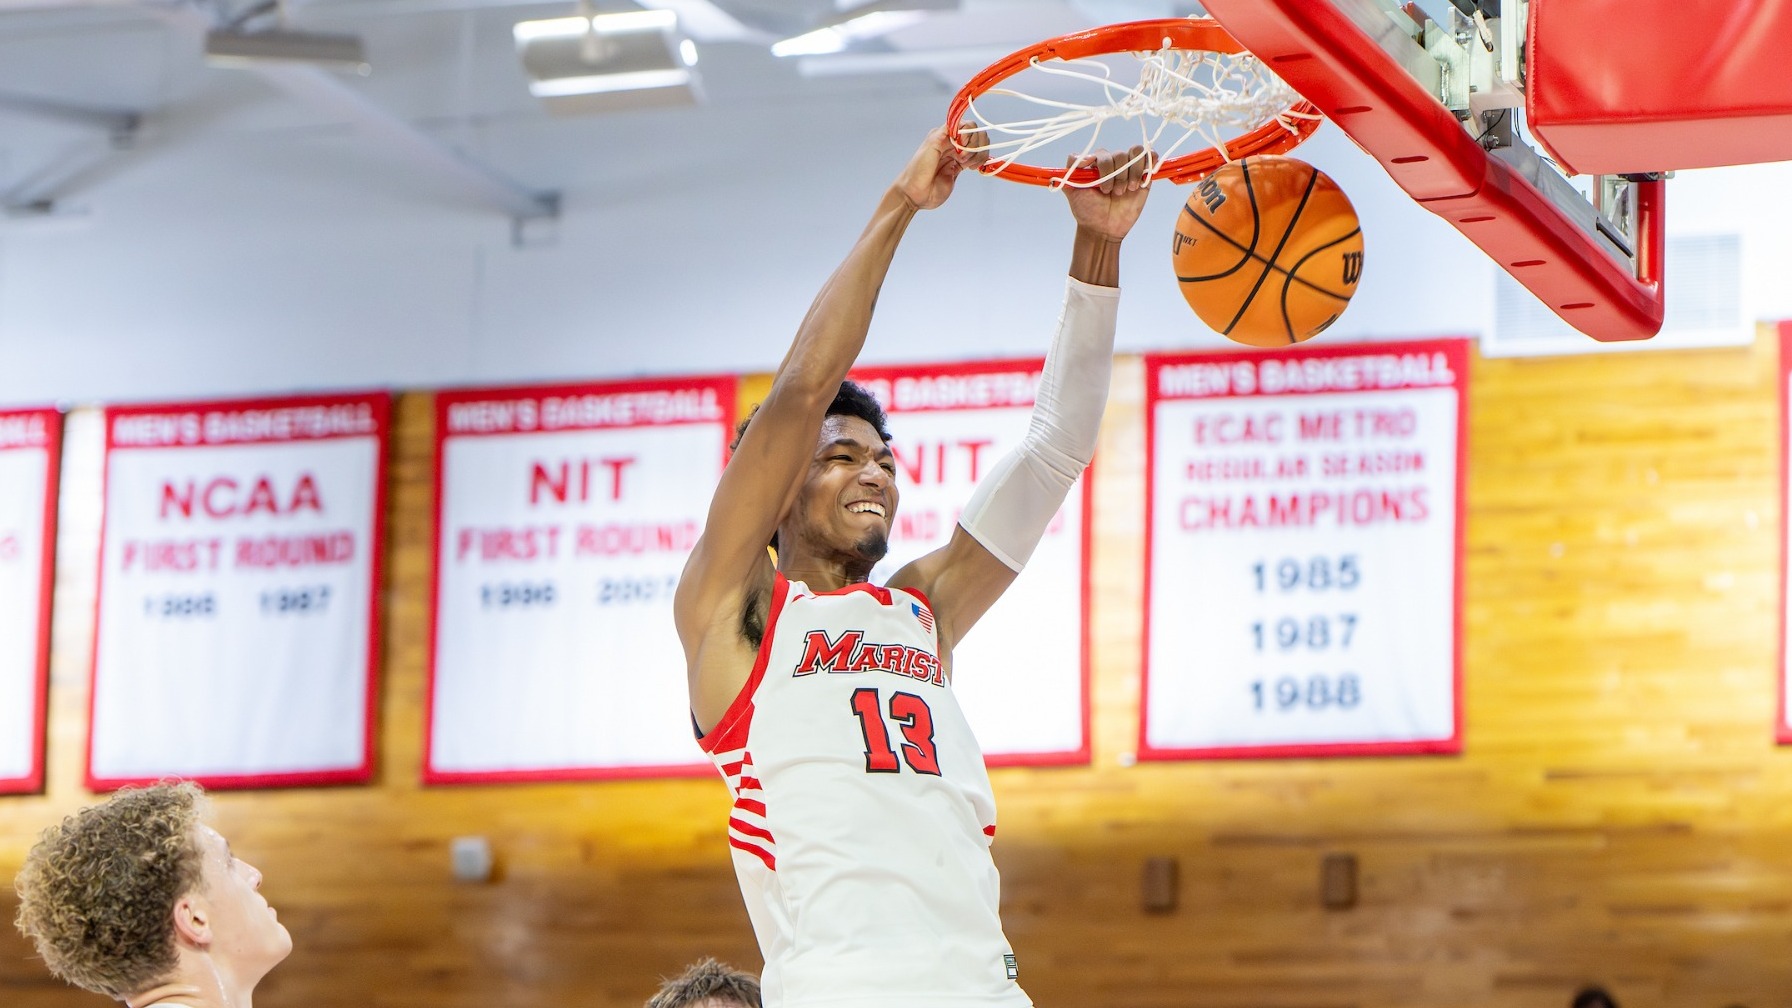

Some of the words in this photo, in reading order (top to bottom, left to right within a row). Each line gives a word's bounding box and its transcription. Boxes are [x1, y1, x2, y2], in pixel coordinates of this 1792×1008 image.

[1159, 362, 1257, 397] MEN'S
[1258, 352, 1456, 394] BASKETBALL
[112, 412, 200, 446] MEN'S
[204, 403, 377, 443] BASKETBALL
[447, 399, 537, 431] MEN'S
[540, 387, 723, 428] BASKETBALL
[1193, 412, 1284, 446] ECAC
[1299, 408, 1418, 442] METRO
[529, 457, 638, 505] NIT
[1187, 456, 1309, 482] REGULAR
[1322, 451, 1425, 477] SEASON
[158, 471, 324, 520] NCAA
[1178, 486, 1431, 531] CHAMPIONS
[122, 538, 221, 572] FIRST
[234, 530, 355, 570] ROUND
[456, 527, 560, 564] FIRST
[1252, 555, 1362, 592] 1985
[1252, 614, 1359, 651] 1987
[1251, 673, 1362, 710] 1988
[850, 688, 942, 777] 13
